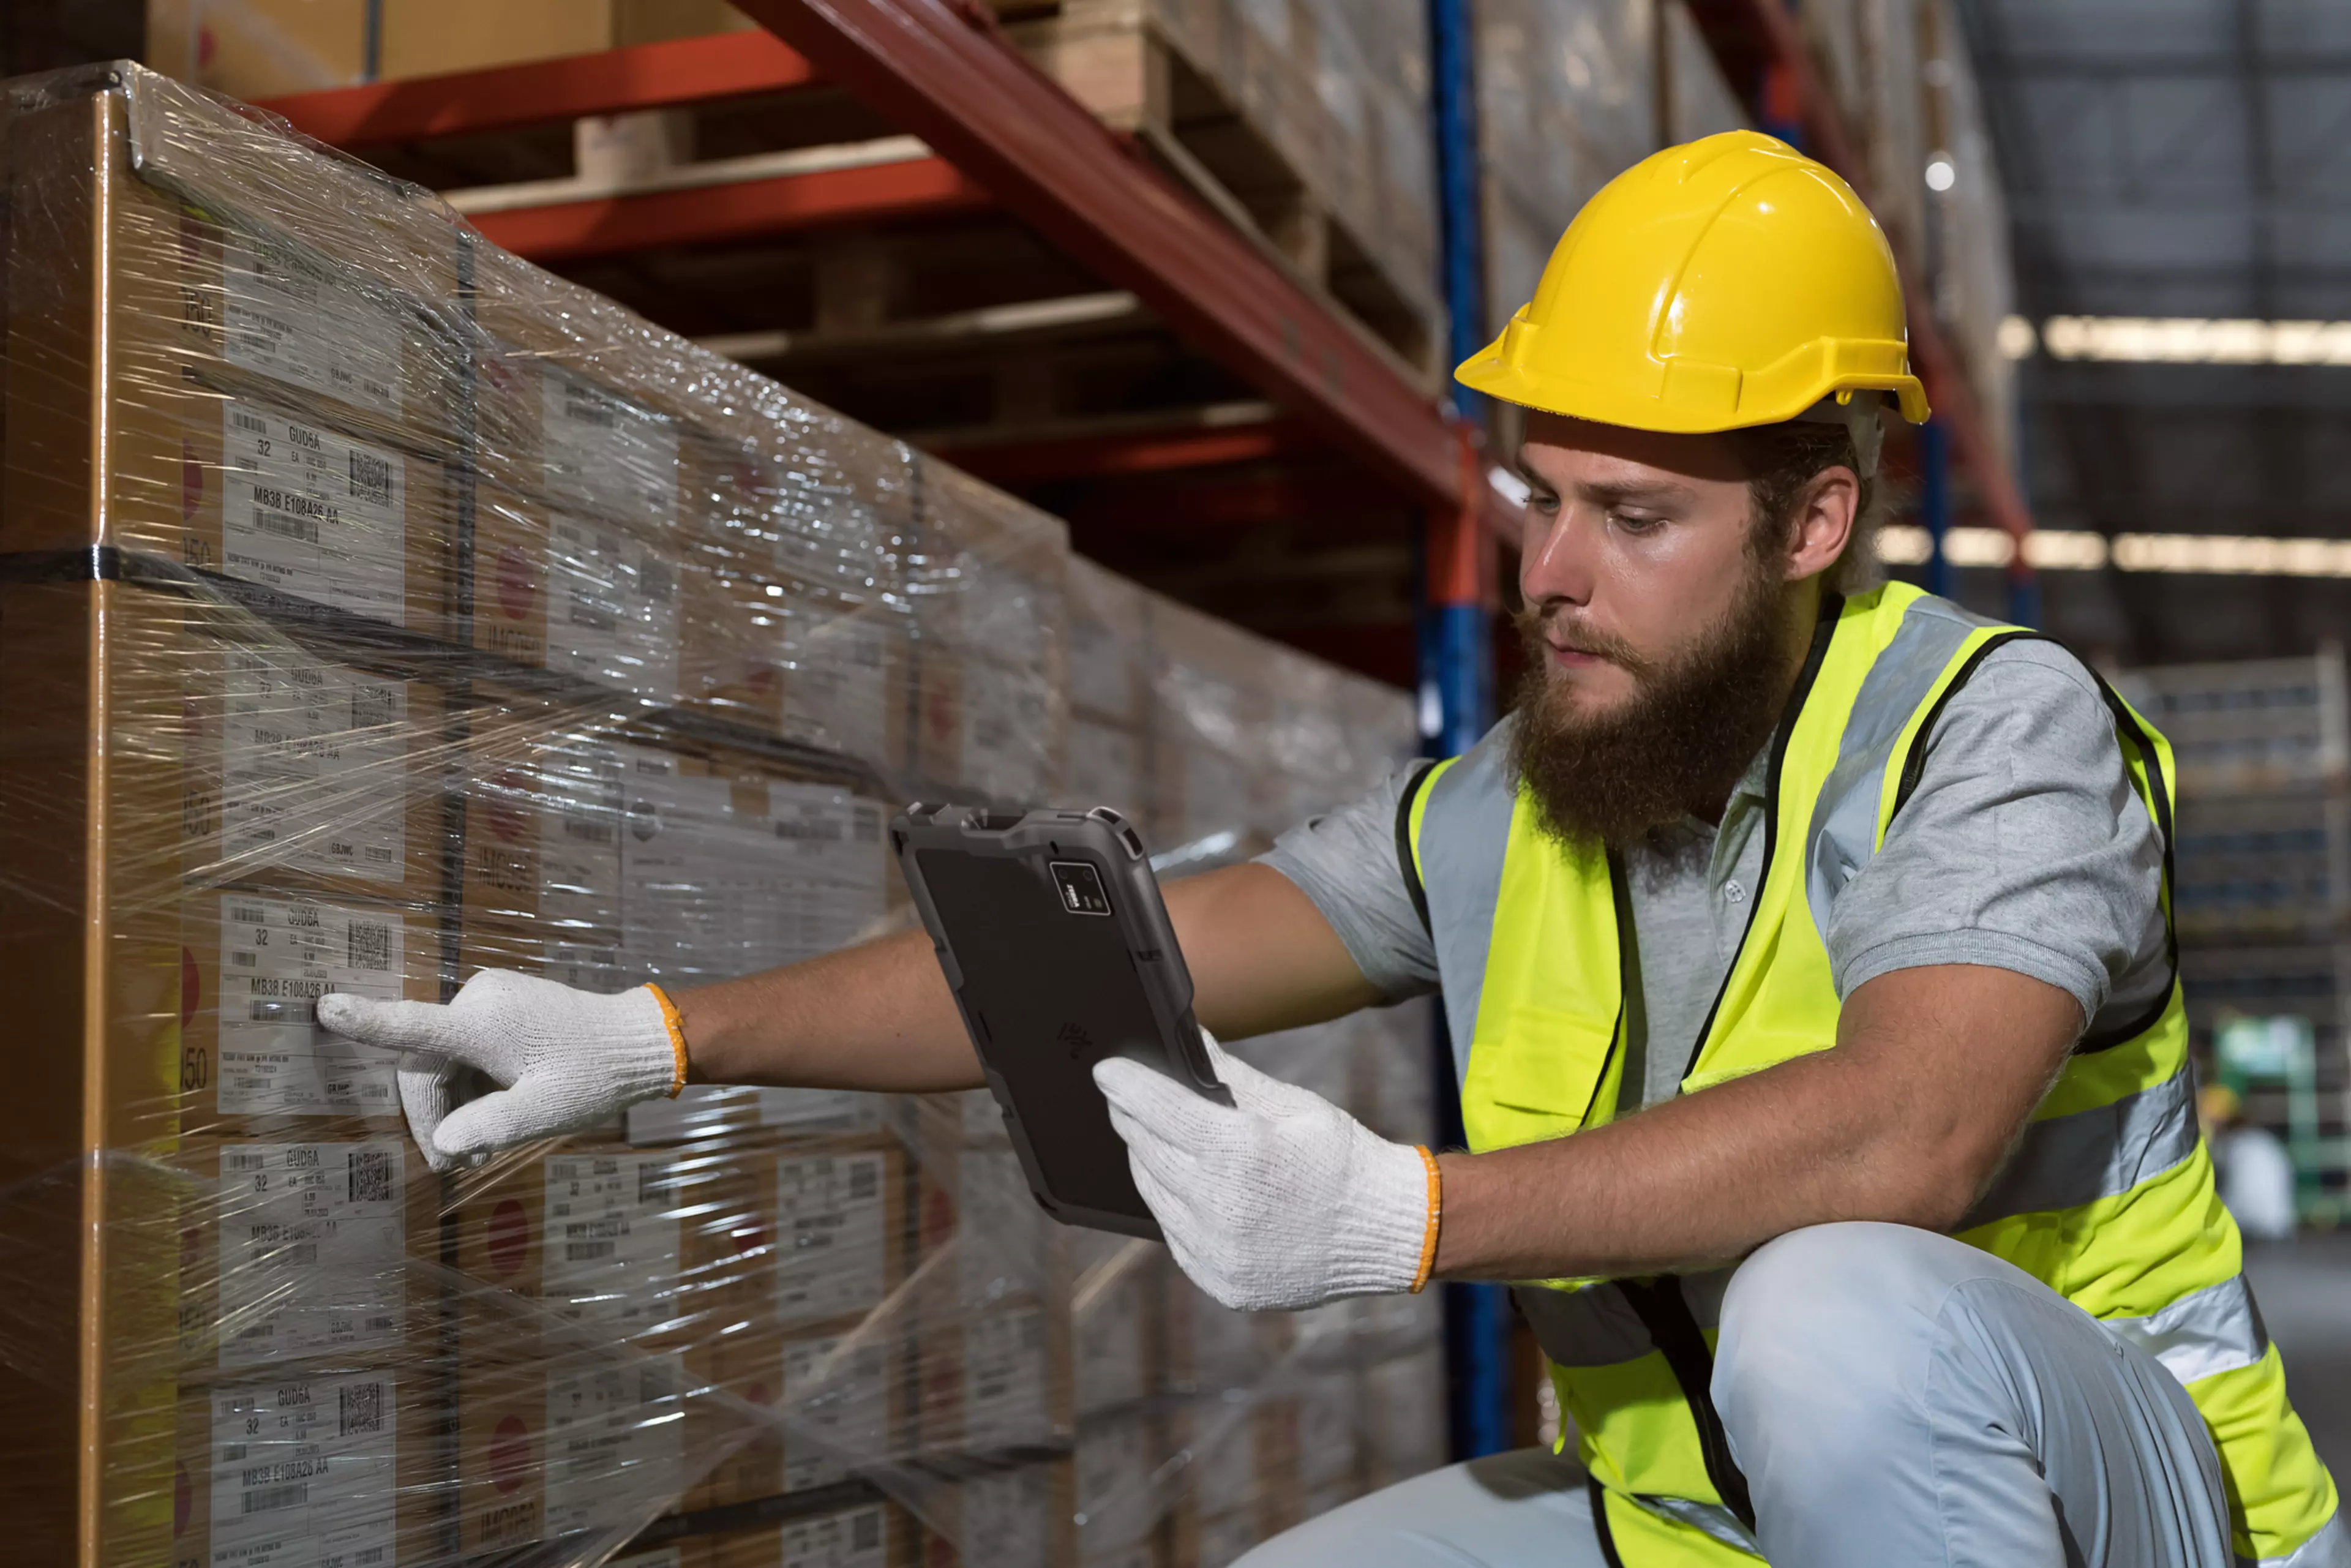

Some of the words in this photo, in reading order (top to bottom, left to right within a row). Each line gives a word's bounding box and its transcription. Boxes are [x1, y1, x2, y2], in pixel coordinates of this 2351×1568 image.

[289, 426, 320, 451] GUD6A
[257, 439, 271, 457] 32
[255, 929, 268, 945] 32
[252, 978, 279, 996] MB3B
[282, 980, 320, 999] E108A26
[287, 1150, 319, 1167] GUD6A
[255, 1175, 267, 1192] 32
[277, 1387, 310, 1407] GUD6A
[246, 1417, 259, 1435] 32
[316, 1457, 329, 1475] AA
